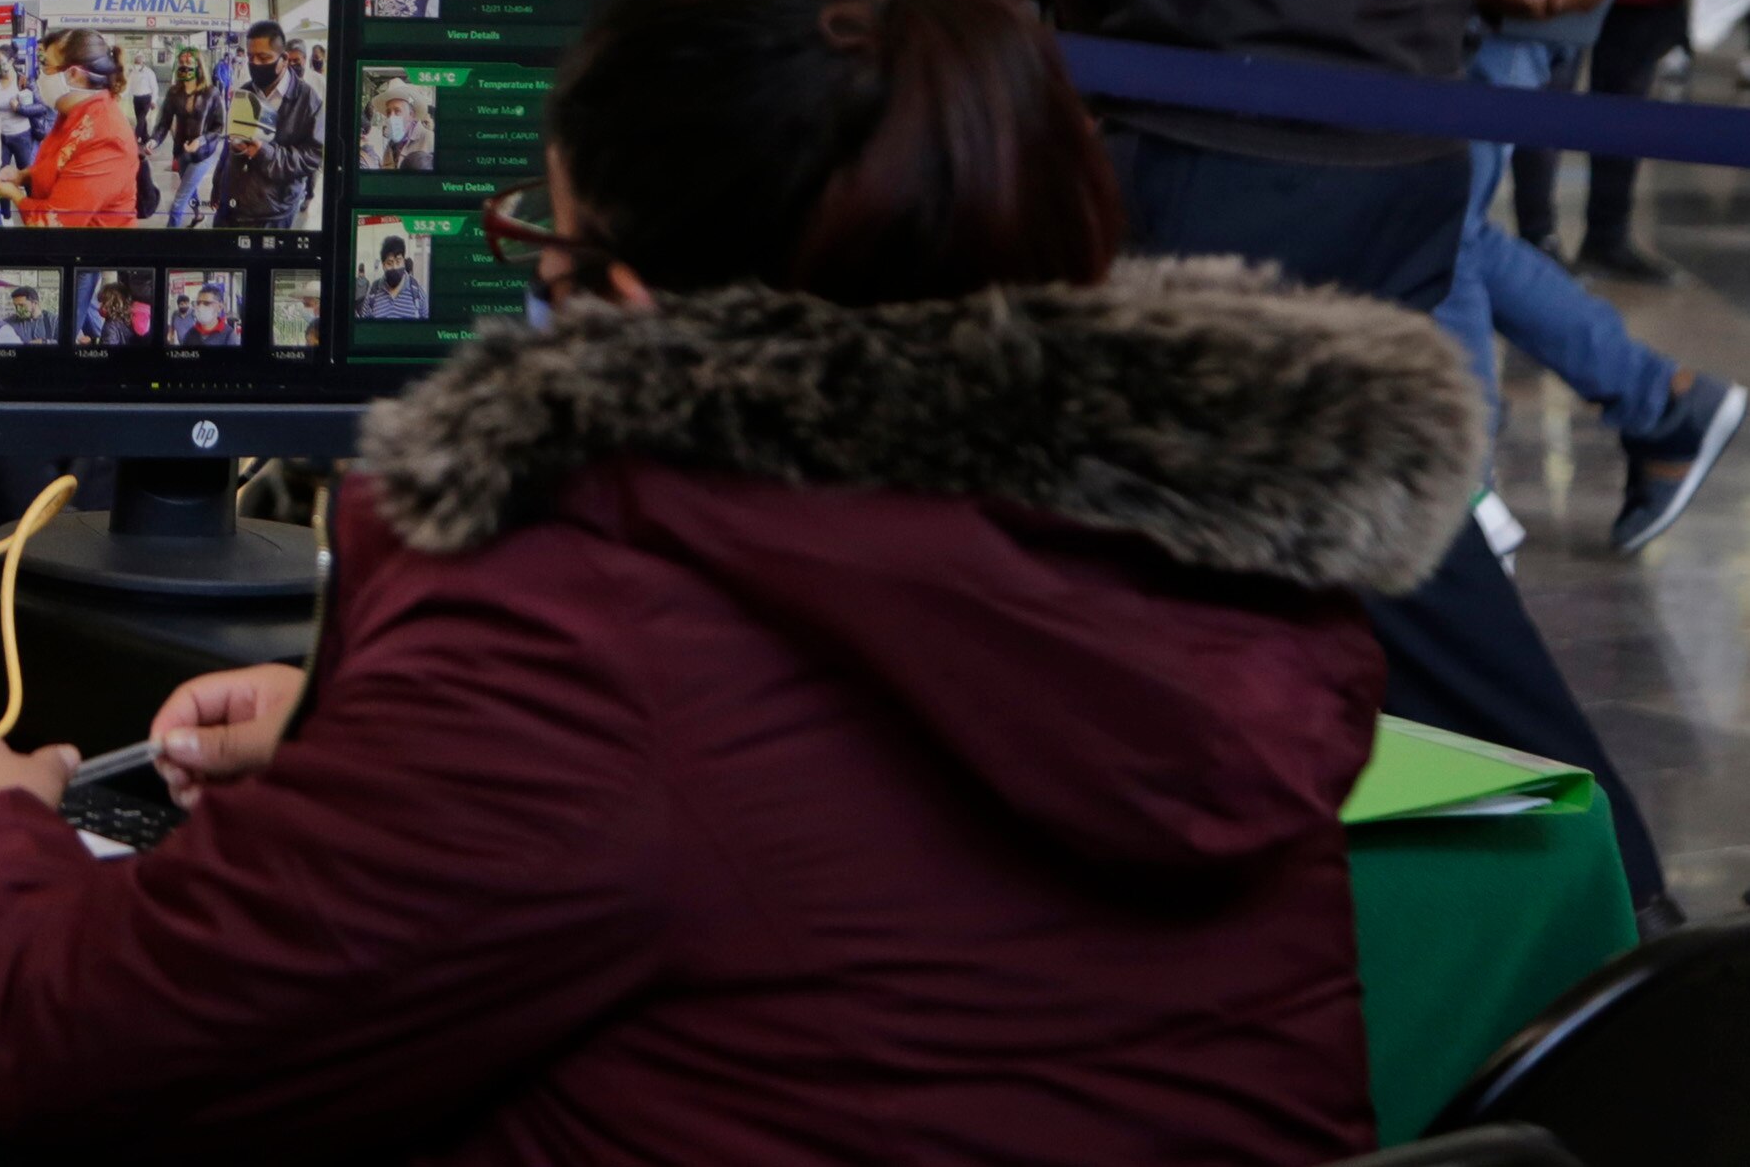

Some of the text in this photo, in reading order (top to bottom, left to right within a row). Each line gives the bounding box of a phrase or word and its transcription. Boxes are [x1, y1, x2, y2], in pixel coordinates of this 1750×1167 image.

[447, 30, 500, 41] View Details
[418, 72, 441, 83] 36.4
[478, 79, 535, 90] Temperature
[442, 182, 495, 193] View Details
[413, 221, 436, 231] 35.2
[471, 254, 494, 263] Wear
[437, 330, 459, 340] View
[194, 421, 217, 447] hp
